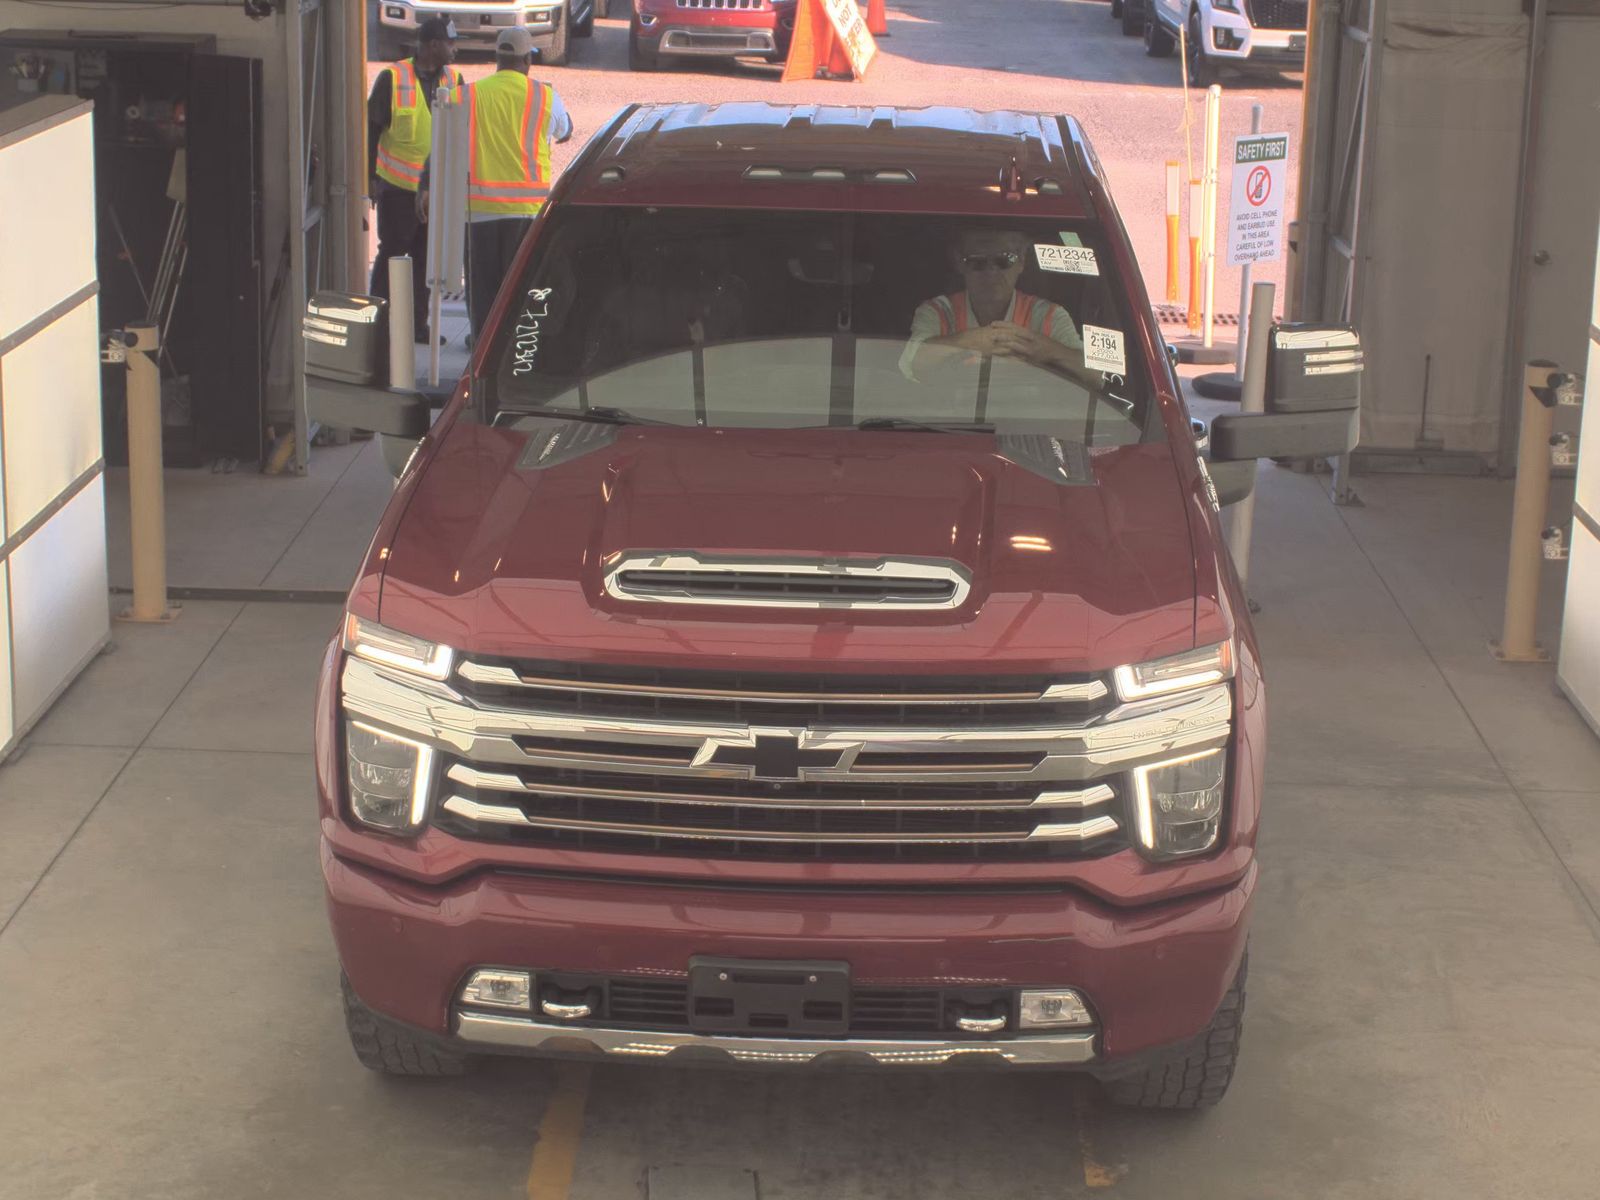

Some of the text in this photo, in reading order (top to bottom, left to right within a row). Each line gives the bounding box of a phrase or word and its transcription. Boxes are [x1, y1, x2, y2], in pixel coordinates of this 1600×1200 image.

[838, 3, 852, 28] NOT
[1237, 140, 1285, 161] SAFETY FIRST
[1236, 209, 1278, 221] AVOID CELL PHONE
[1237, 219, 1276, 231] AND EARBUD USE
[1247, 231, 1257, 239] THIS
[1258, 230, 1270, 239] AREA
[1236, 239, 1275, 251] CAREFUL OF LOW
[1038, 247, 1096, 262] 7212342
[1233, 249, 1276, 261] OVERHANG AHEAD
